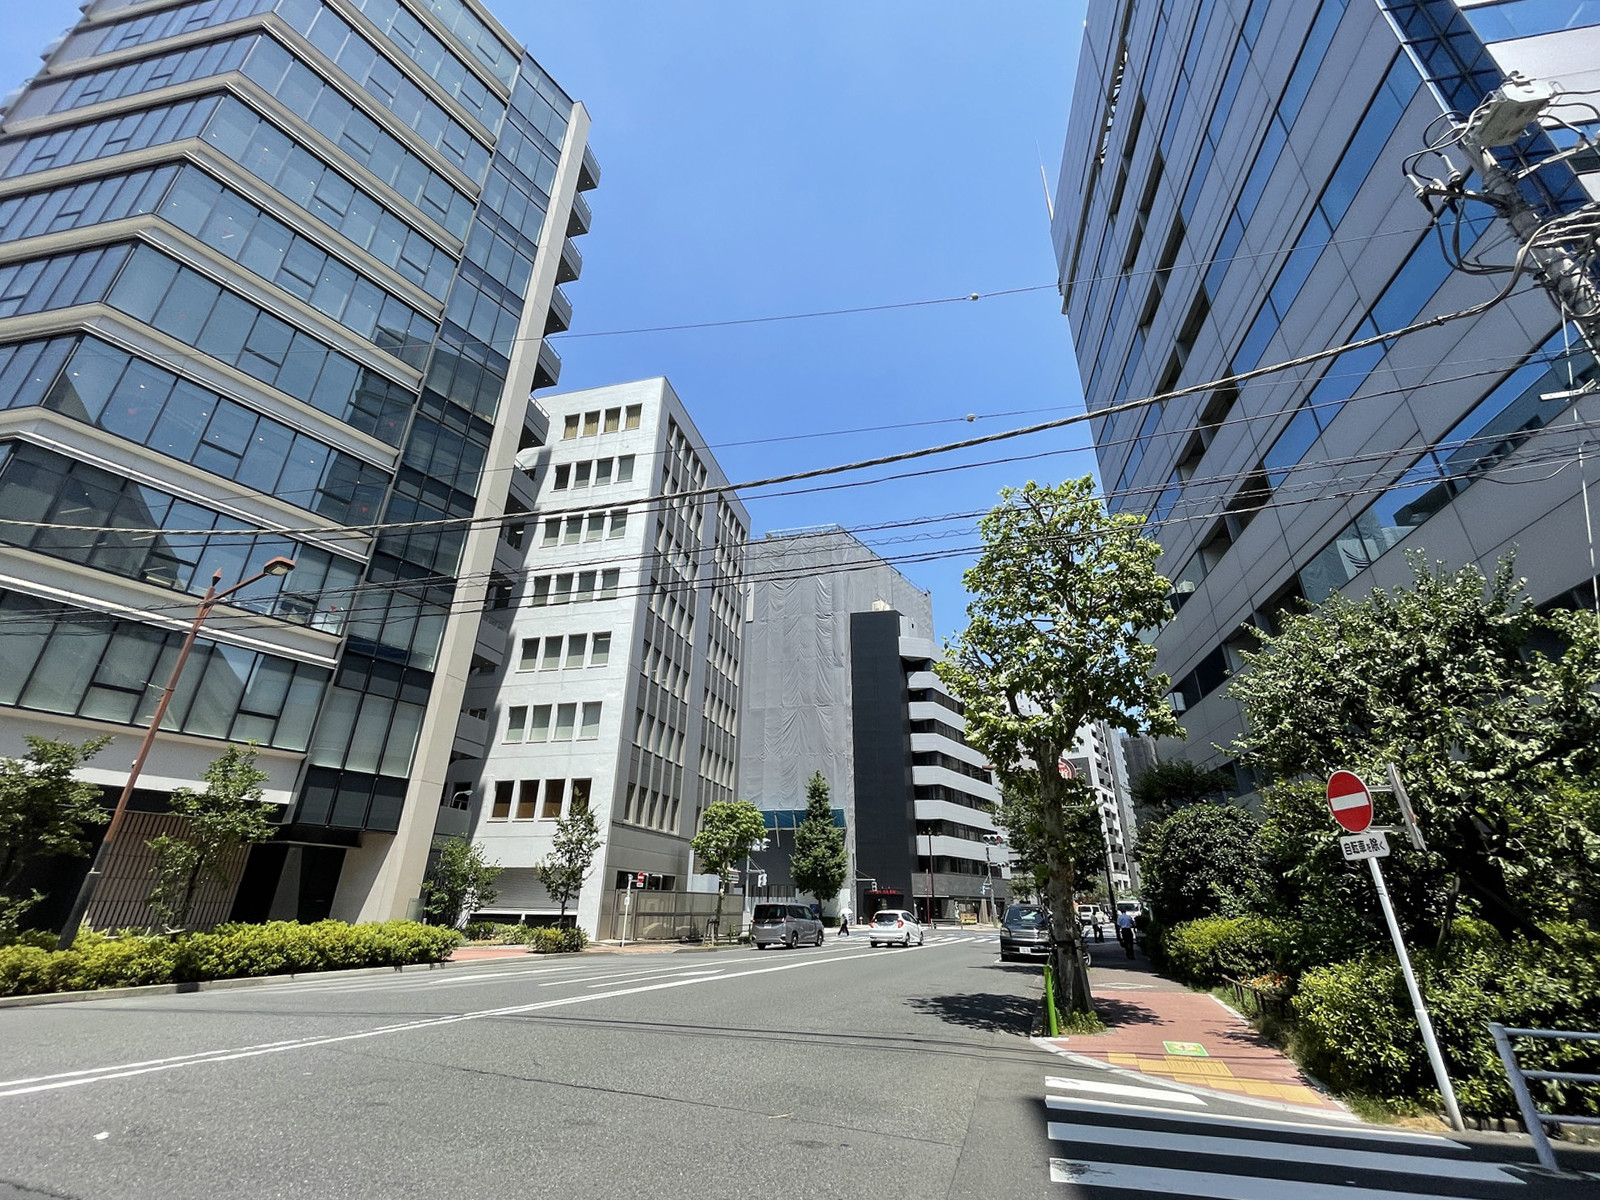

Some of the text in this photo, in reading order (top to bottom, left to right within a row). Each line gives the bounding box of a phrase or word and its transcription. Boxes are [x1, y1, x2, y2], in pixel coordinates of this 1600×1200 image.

[1344, 838, 1386, 855] 自転車を除く
